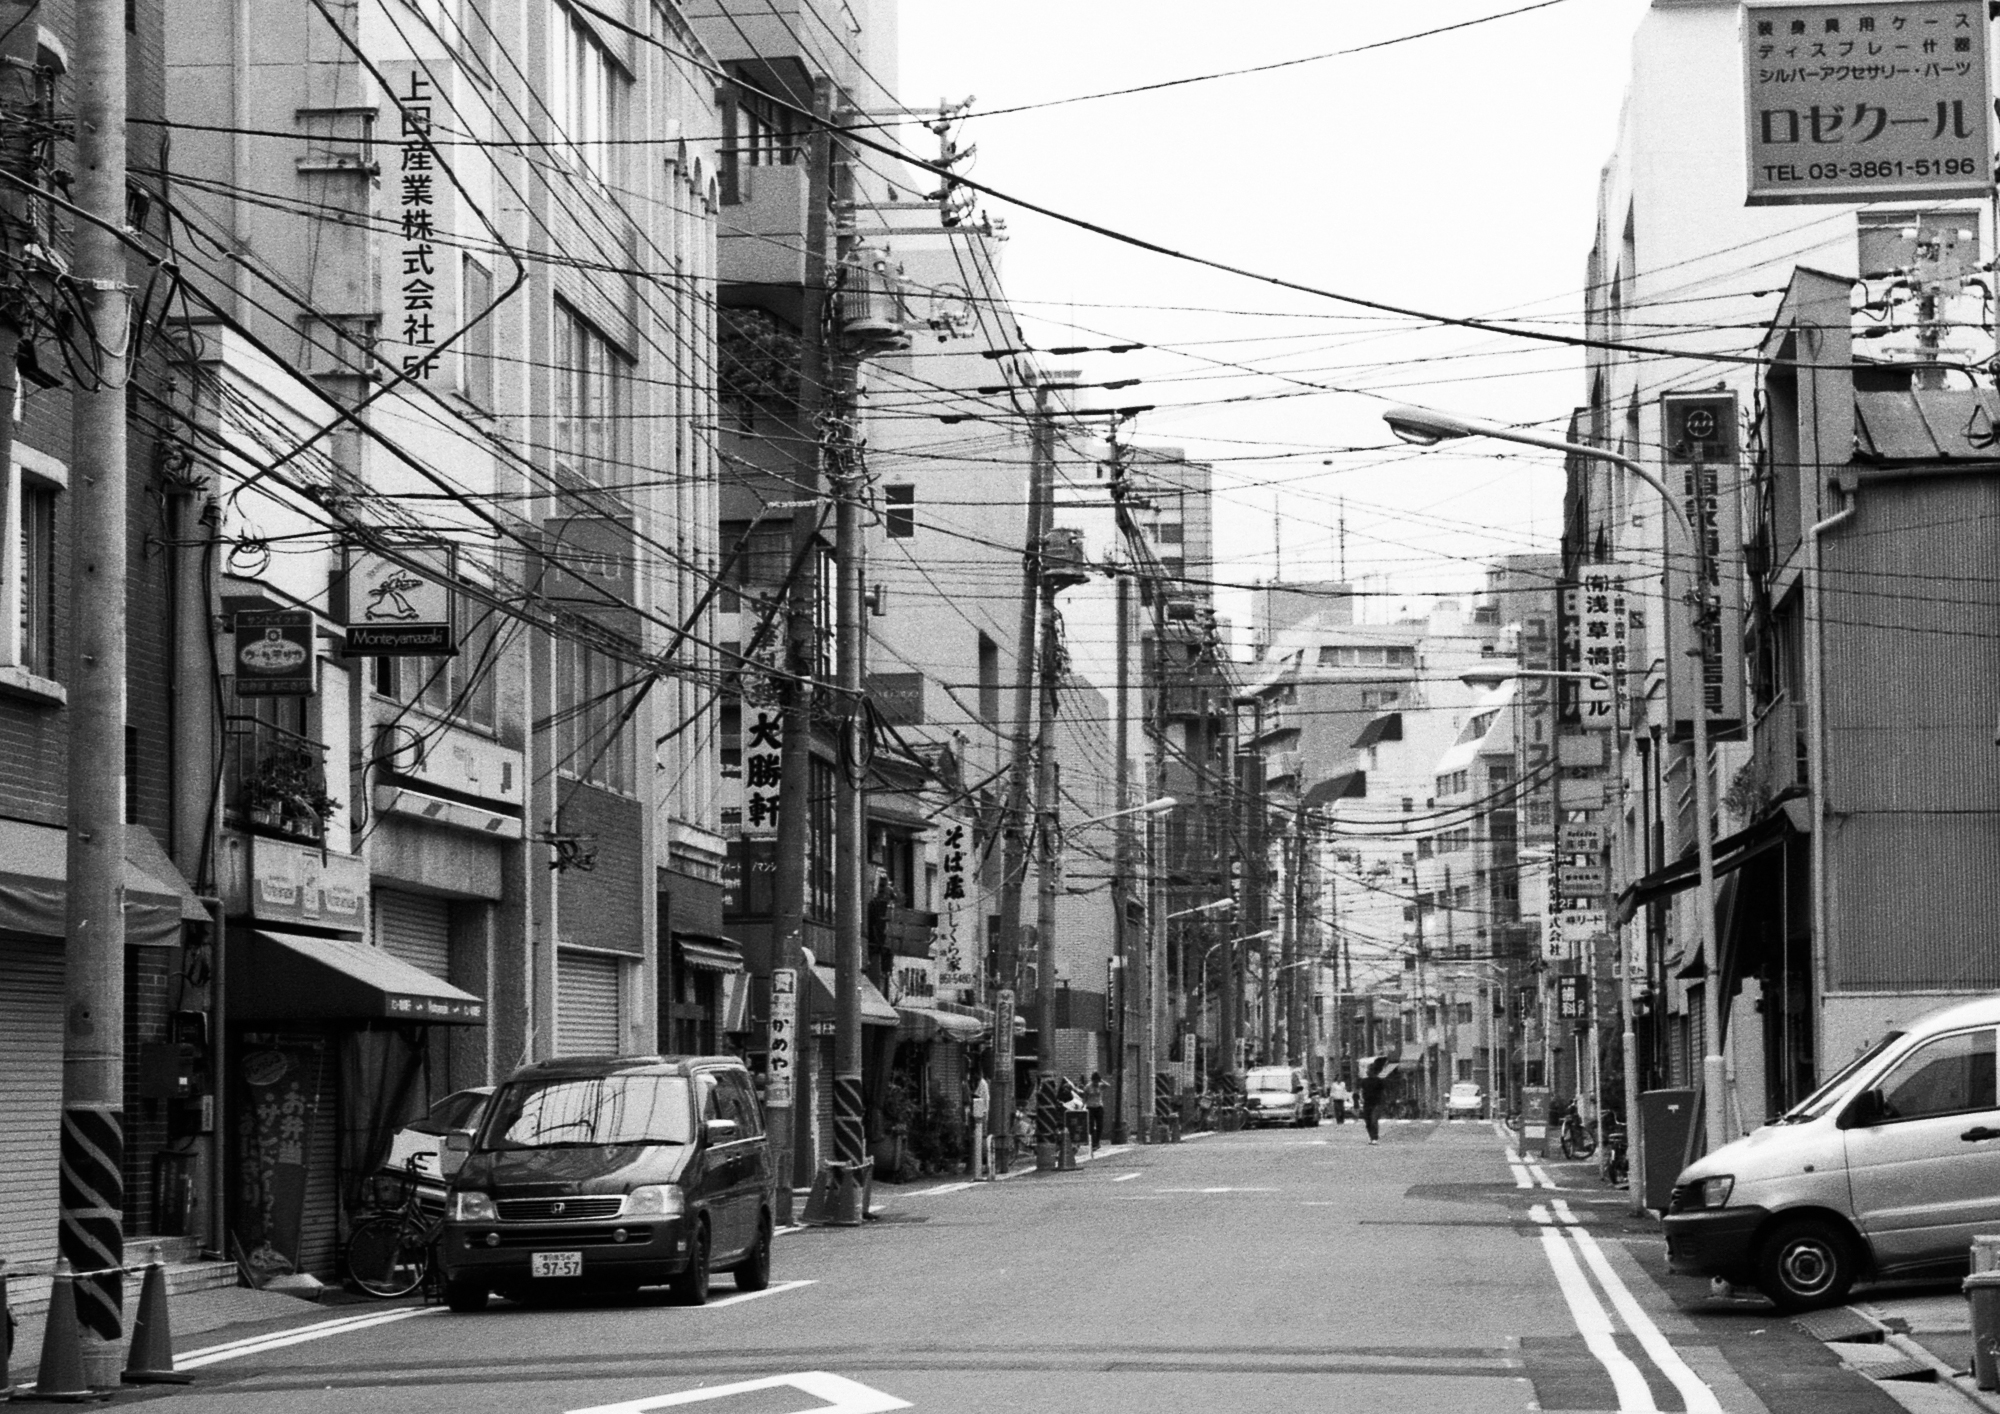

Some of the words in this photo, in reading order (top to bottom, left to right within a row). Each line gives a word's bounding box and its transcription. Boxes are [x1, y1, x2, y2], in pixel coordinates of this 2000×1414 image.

[1758, 36, 1971, 59] ディスプレー什器
[1760, 99, 1974, 145] ロゼクール
[1763, 164, 1804, 181] TEL
[1808, 157, 1975, 180] 03-3861-5196
[353, 627, 443, 647] Monteyamazaki
[747, 711, 783, 828] 大勝軒
[771, 1018, 790, 1071] かめや
[543, 1261, 580, 1276] 97-57
